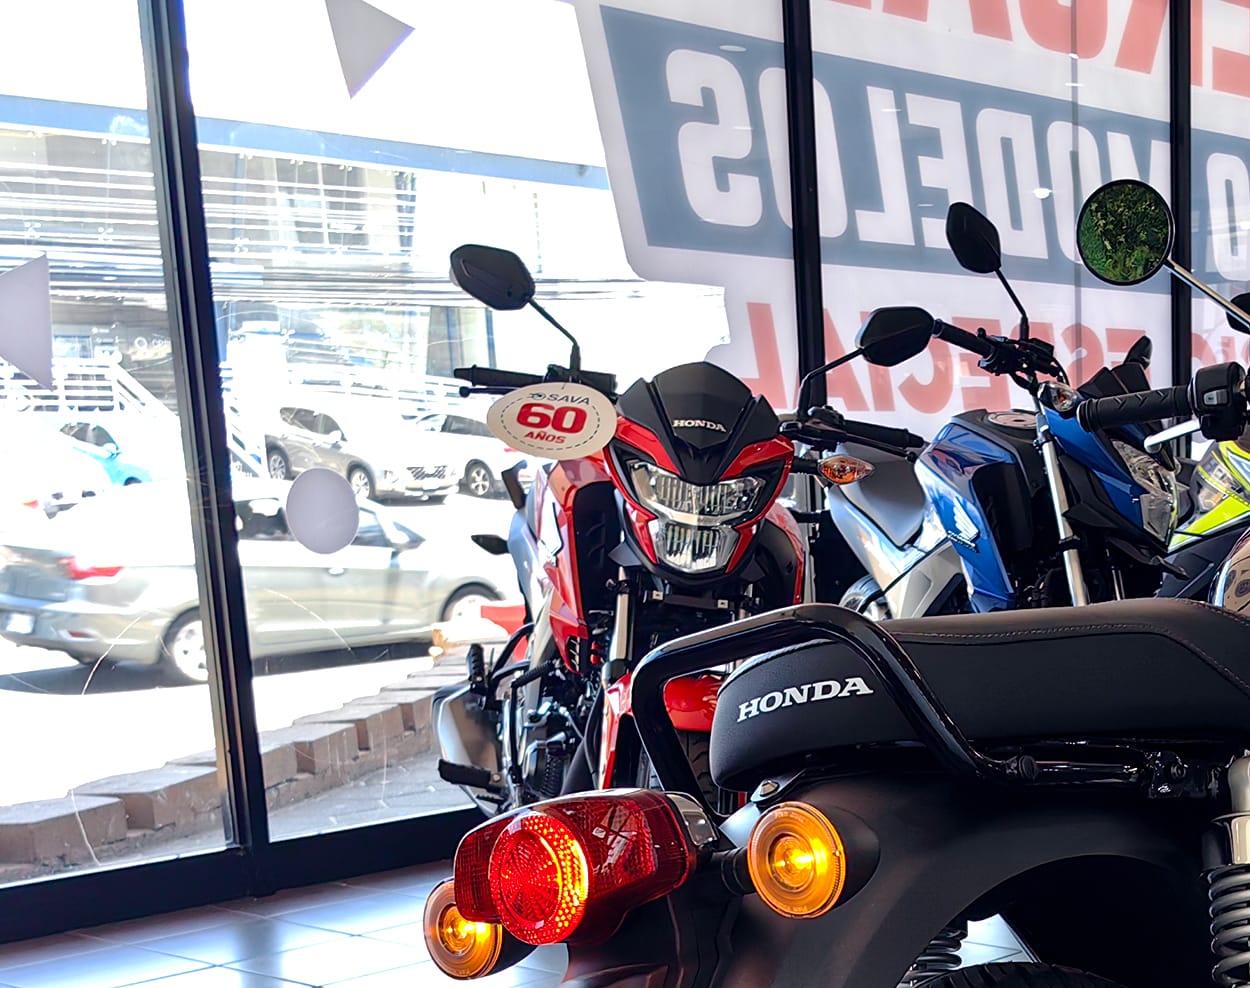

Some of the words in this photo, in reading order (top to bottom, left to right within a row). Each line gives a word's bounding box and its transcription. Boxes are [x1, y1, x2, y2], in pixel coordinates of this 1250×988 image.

[547, 393, 590, 406] SAVA
[516, 403, 588, 434] 60
[672, 419, 727, 433] HONDA
[524, 431, 566, 444] AÑOS
[737, 677, 874, 722] HONDA
